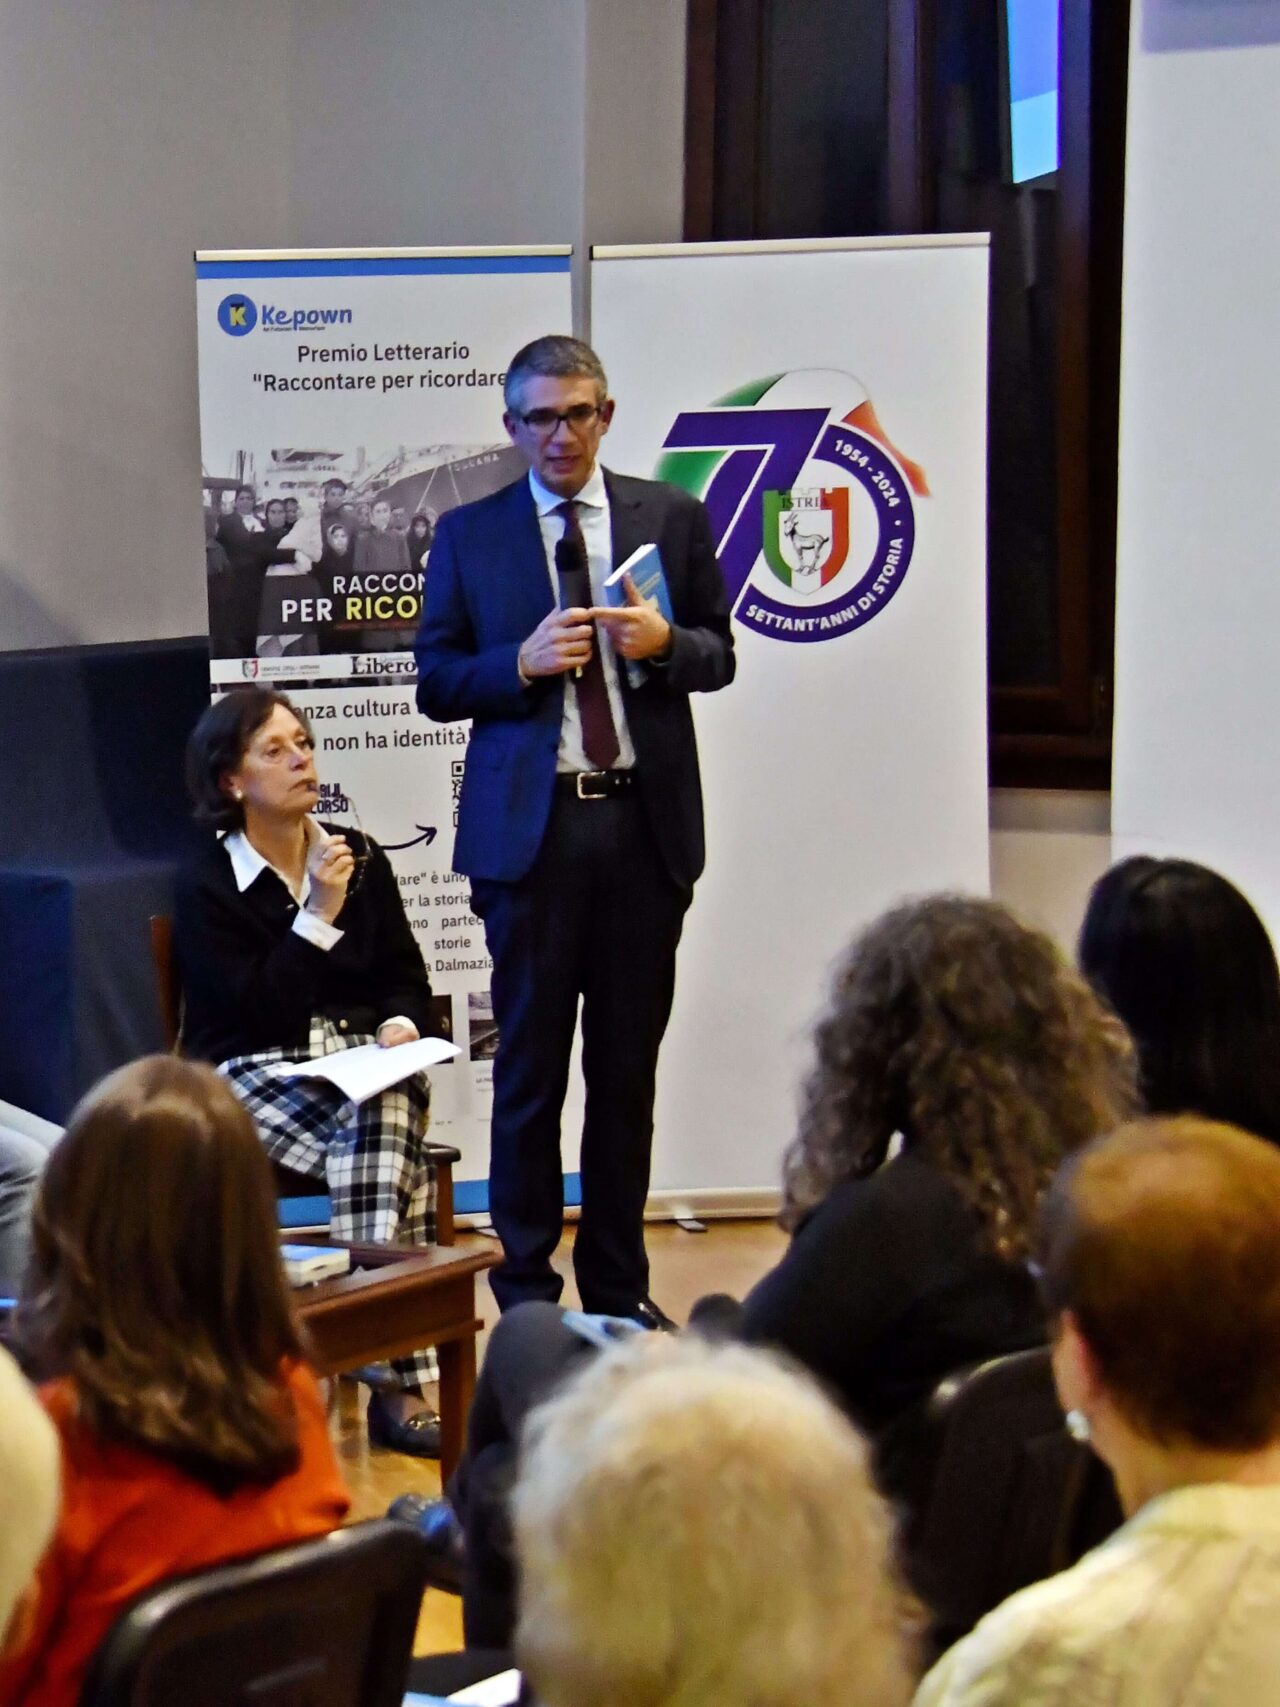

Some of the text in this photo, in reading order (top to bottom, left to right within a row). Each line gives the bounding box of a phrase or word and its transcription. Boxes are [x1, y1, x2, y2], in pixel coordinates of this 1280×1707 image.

[297, 342, 470, 363] Premio Letterario
[253, 373, 376, 392] "Raccontare
[382, 372, 414, 393] per
[745, 538, 904, 632] SETTANT'ANNI DI STORIA
[281, 594, 424, 623] PER RICO
[350, 655, 417, 675] Libero
[343, 699, 411, 718] cultura
[323, 736, 359, 750] non
[365, 731, 388, 749] ha
[418, 894, 430, 906] la
[434, 892, 471, 906] storia
[410, 919, 429, 929] no
[434, 936, 471, 950] storie
[435, 957, 494, 972] Dalmazia
